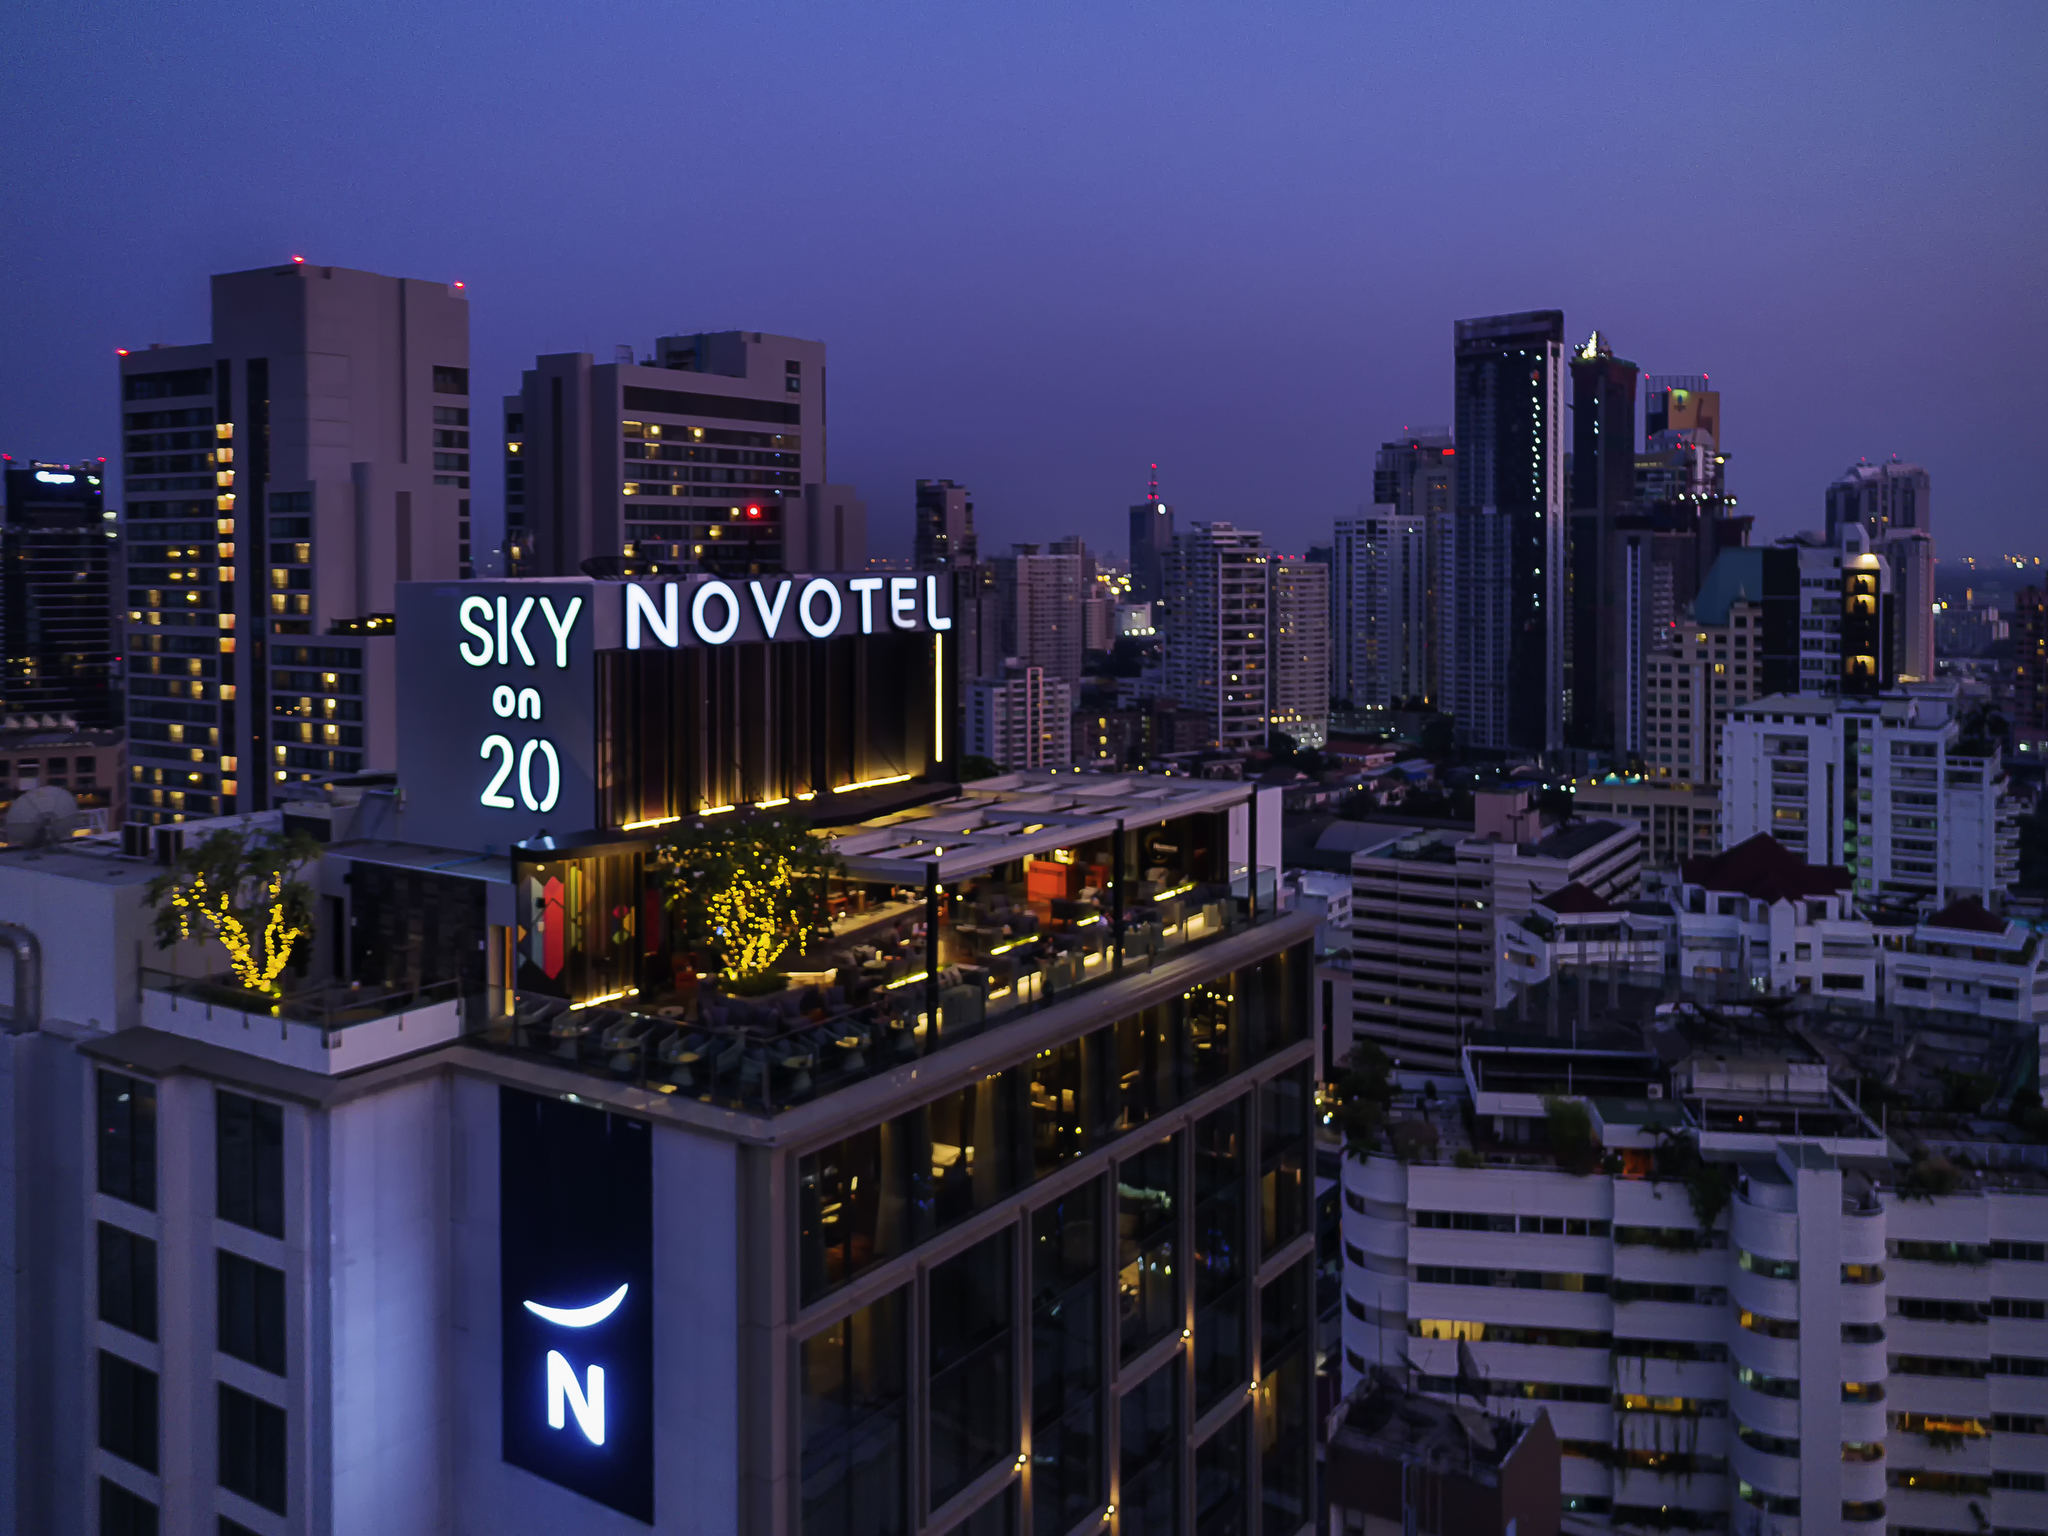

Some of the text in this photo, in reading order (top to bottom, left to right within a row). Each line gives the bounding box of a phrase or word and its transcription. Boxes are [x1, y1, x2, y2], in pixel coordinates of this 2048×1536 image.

[459, 596, 582, 668] SKY
[626, 575, 951, 649] NOVOTEL
[492, 685, 541, 720] on
[480, 734, 560, 813] 20
[547, 1349, 605, 1446] N
